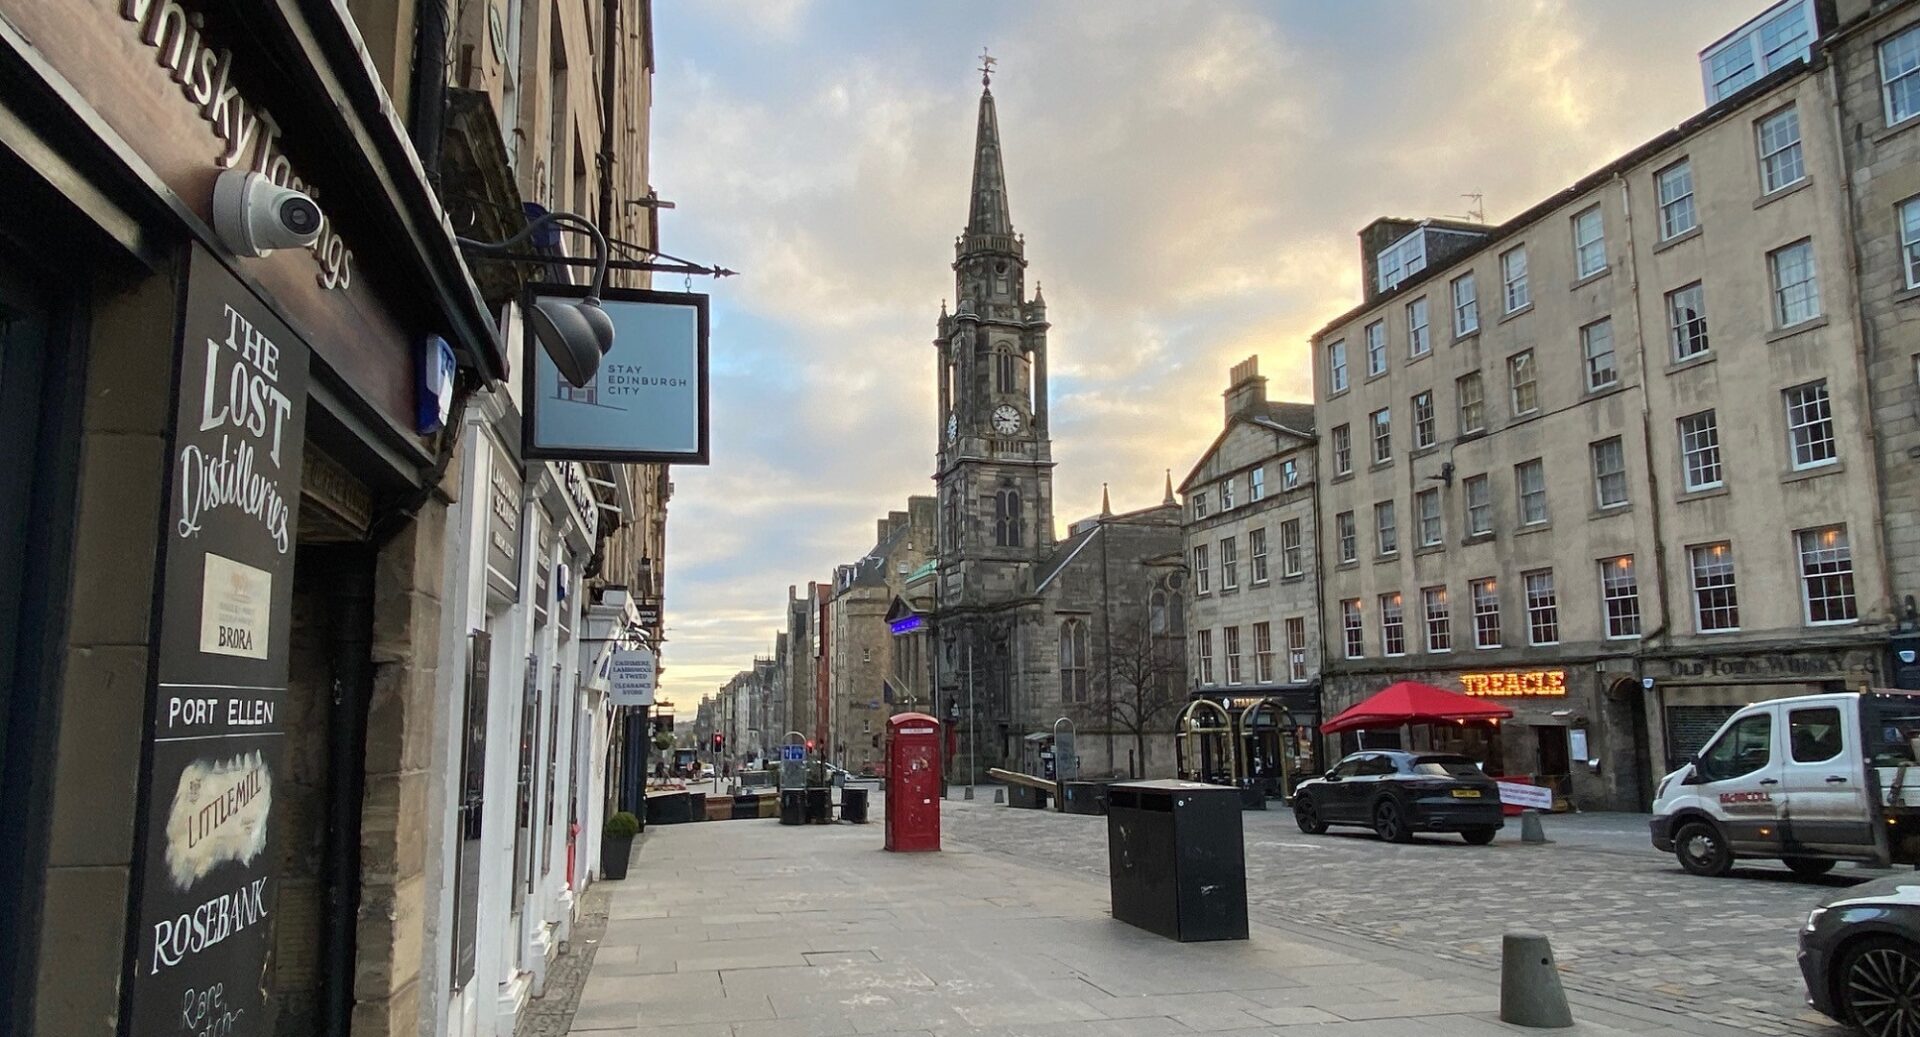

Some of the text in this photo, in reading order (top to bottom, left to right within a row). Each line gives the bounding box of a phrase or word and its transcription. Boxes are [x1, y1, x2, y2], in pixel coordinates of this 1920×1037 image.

[224, 303, 280, 382] THE
[608, 364, 642, 374] STAY
[608, 375, 687, 387] EDINBURGH
[200, 338, 291, 469] LOST
[608, 386, 640, 395] CITY
[178, 434, 289, 554] Distilleries
[218, 625, 253, 651] BRORA
[1460, 671, 1566, 697] TREACLE
[169, 697, 274, 728] PORT ELLEN
[188, 769, 261, 849] LITTLEMILL
[151, 876, 269, 976] ROSEBANK
[182, 982, 223, 1029] Rare
